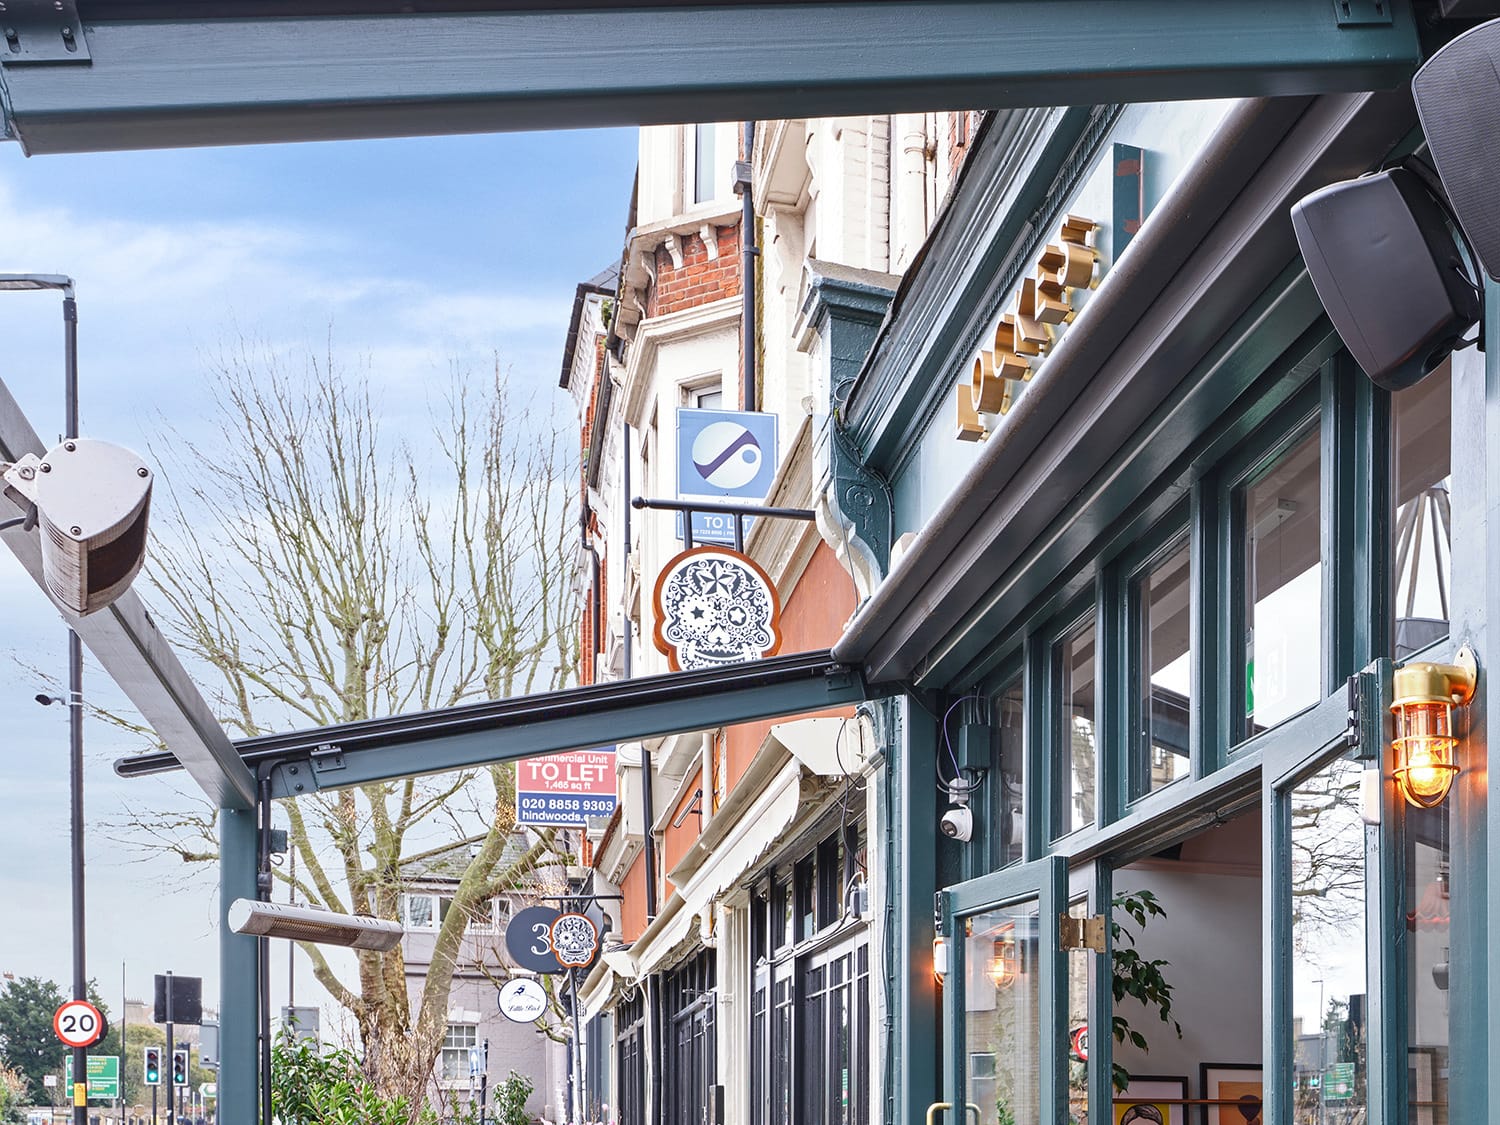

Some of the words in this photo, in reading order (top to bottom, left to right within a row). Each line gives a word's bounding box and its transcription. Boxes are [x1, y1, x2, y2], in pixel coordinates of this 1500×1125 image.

[956, 213, 1095, 443] LOCKES
[703, 516, 723, 529] TO
[727, 518, 751, 531] LT
[588, 755, 608, 764] Unit
[526, 762, 559, 781] TO
[566, 763, 609, 782] LET
[544, 781, 569, 790] 1,465
[571, 783, 582, 791] sq
[584, 782, 591, 790] ft
[522, 798, 545, 809] 020
[548, 799, 579, 810] 8858
[583, 801, 613, 811] 9303
[522, 810, 613, 822] hindwoods.c
[62, 1014, 95, 1033] 20
